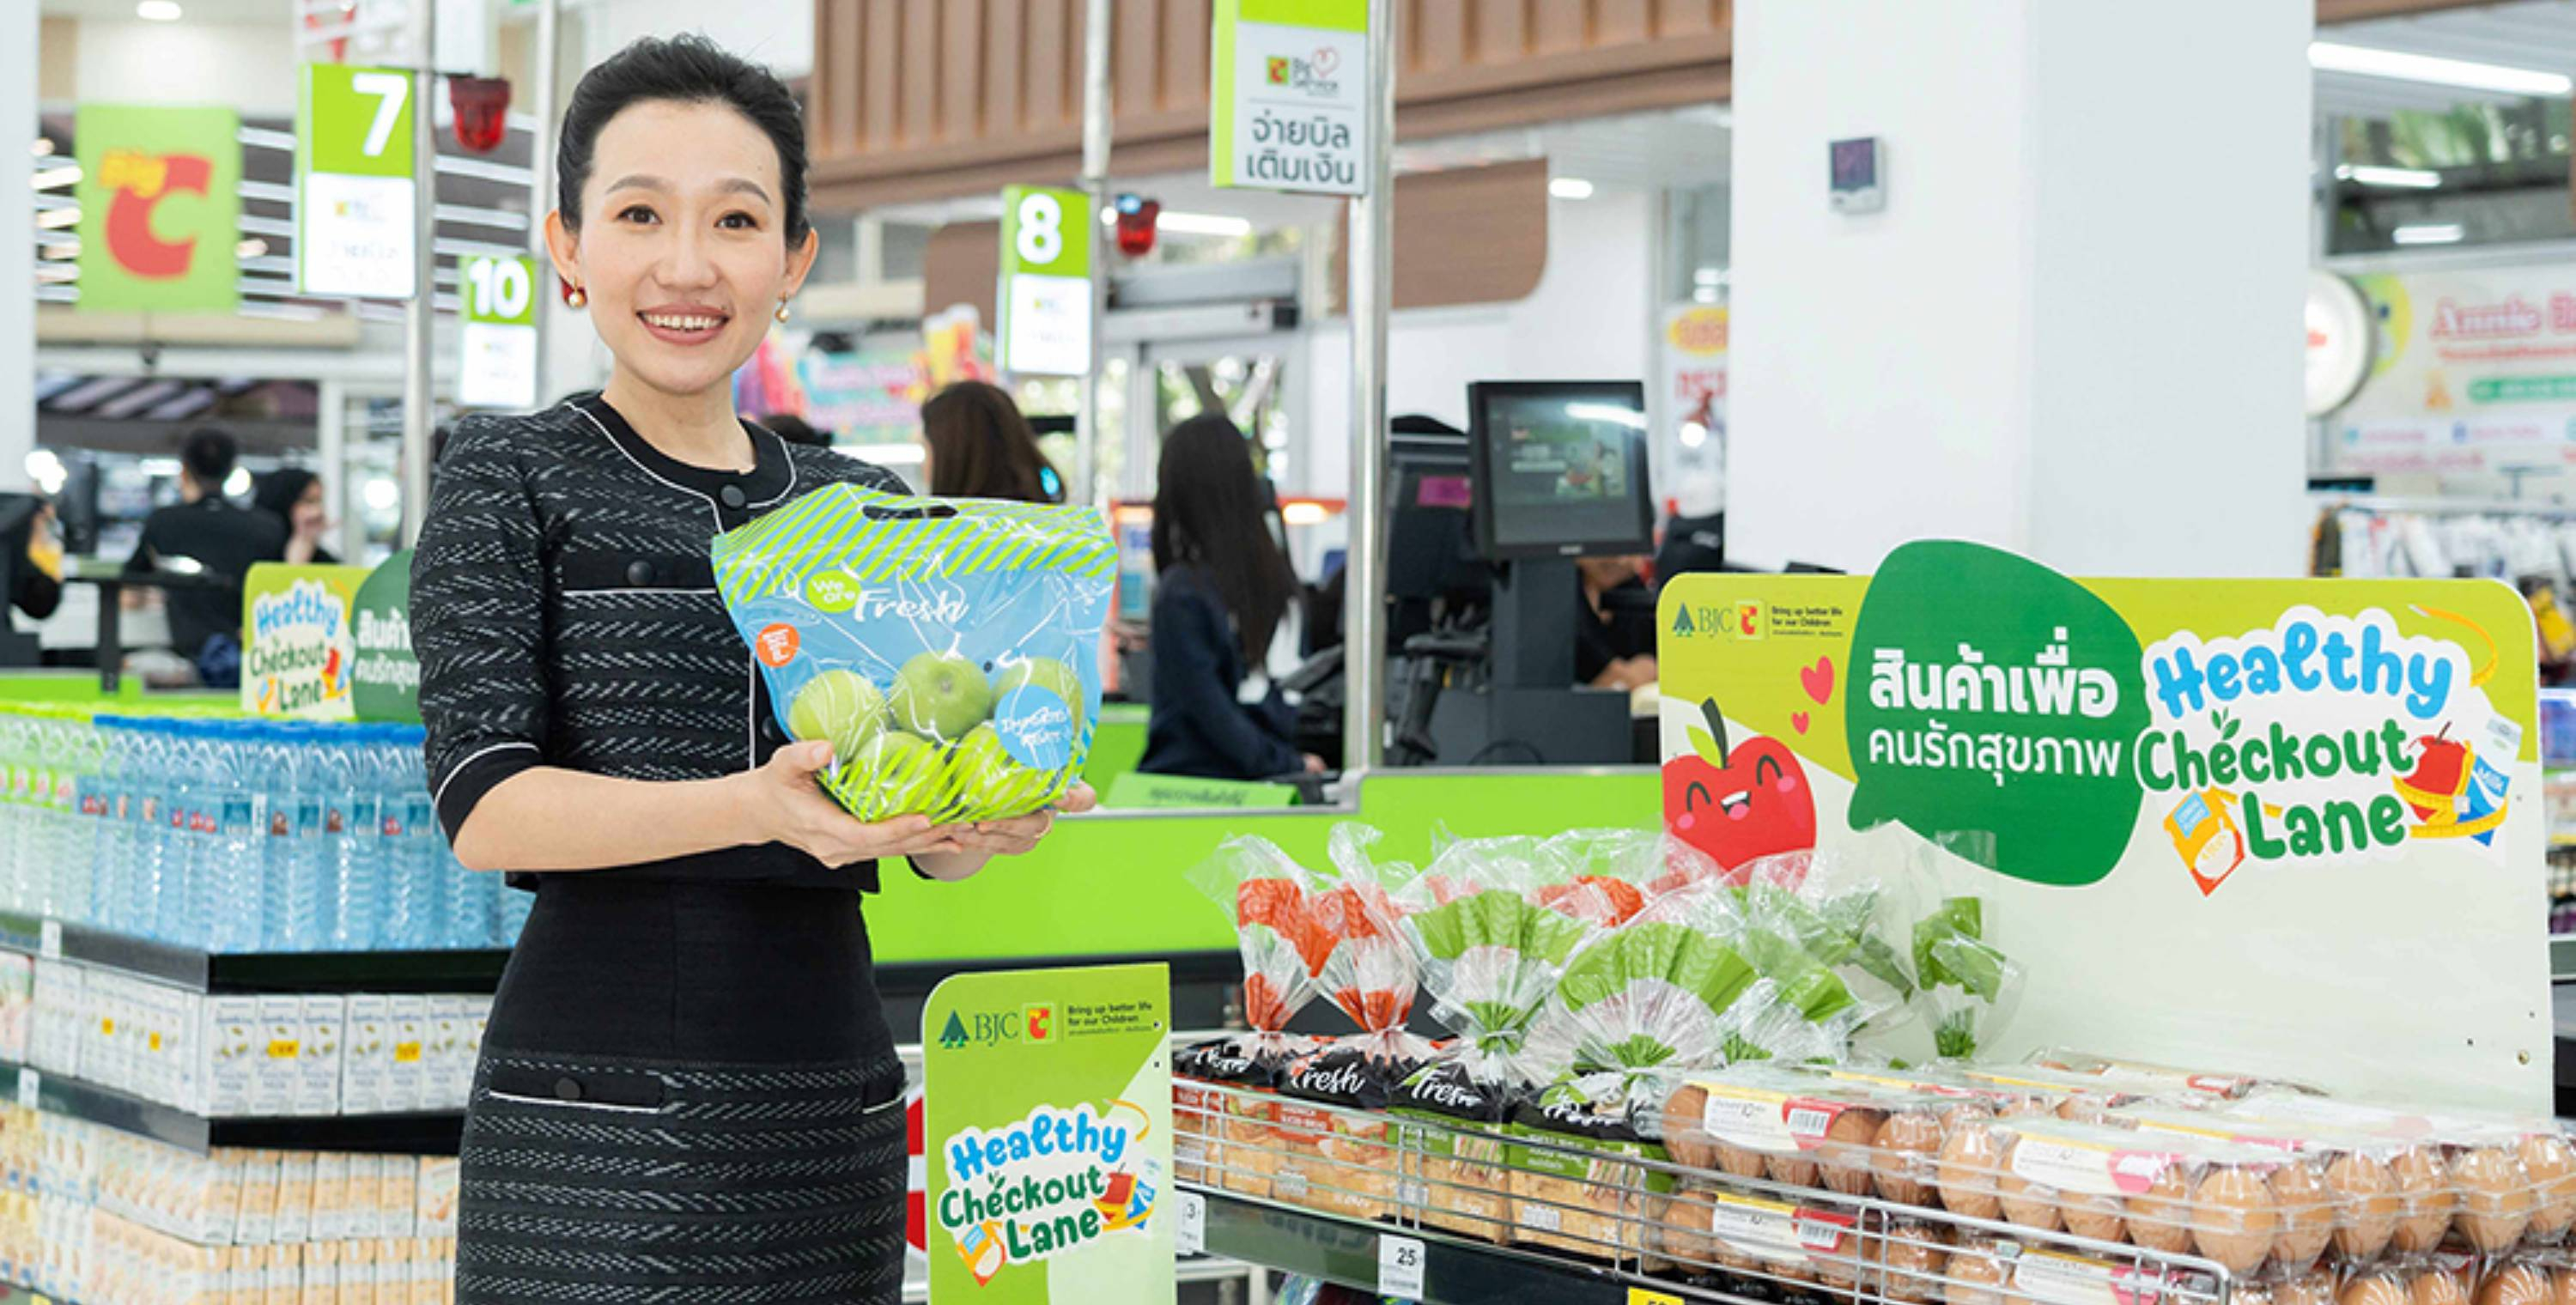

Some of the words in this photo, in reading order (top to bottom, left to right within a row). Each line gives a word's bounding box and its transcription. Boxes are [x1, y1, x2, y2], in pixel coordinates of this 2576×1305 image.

[351, 74, 409, 157] 7
[1253, 108, 1350, 149] จ่ายบิล
[1247, 149, 1355, 185] เติมเงิน
[1017, 193, 1062, 264] 8
[469, 258, 530, 318] 10
[811, 580, 845, 593] We
[823, 591, 856, 604] are
[854, 587, 969, 623] Fresh
[258, 588, 339, 638] Healthy
[1698, 607, 1733, 639] BJC
[249, 640, 327, 677] Checkout
[1869, 627, 2118, 718] สินค้าเพื่อ
[2154, 622, 2452, 719] Healthy
[277, 678, 322, 711] Lane
[1869, 719, 2122, 787] คนรักสุขภาพ
[2138, 719, 2415, 791] Checkout
[2242, 791, 2406, 859] Lane
[974, 1012, 1019, 1047] BJC
[1068, 1005, 1092, 1017] Bring
[1095, 1005, 1106, 1015] up
[1109, 1003, 1135, 1012] better
[1138, 1001, 1153, 1011] life
[1068, 1017, 1081, 1027] for
[1084, 1017, 1099, 1026] our
[1103, 1014, 1139, 1025] Children
[951, 1112, 1127, 1181] Healthy
[941, 1164, 1106, 1229] Checkout
[1006, 1208, 1100, 1259] Lane
[1397, 1247, 1418, 1266] 25
